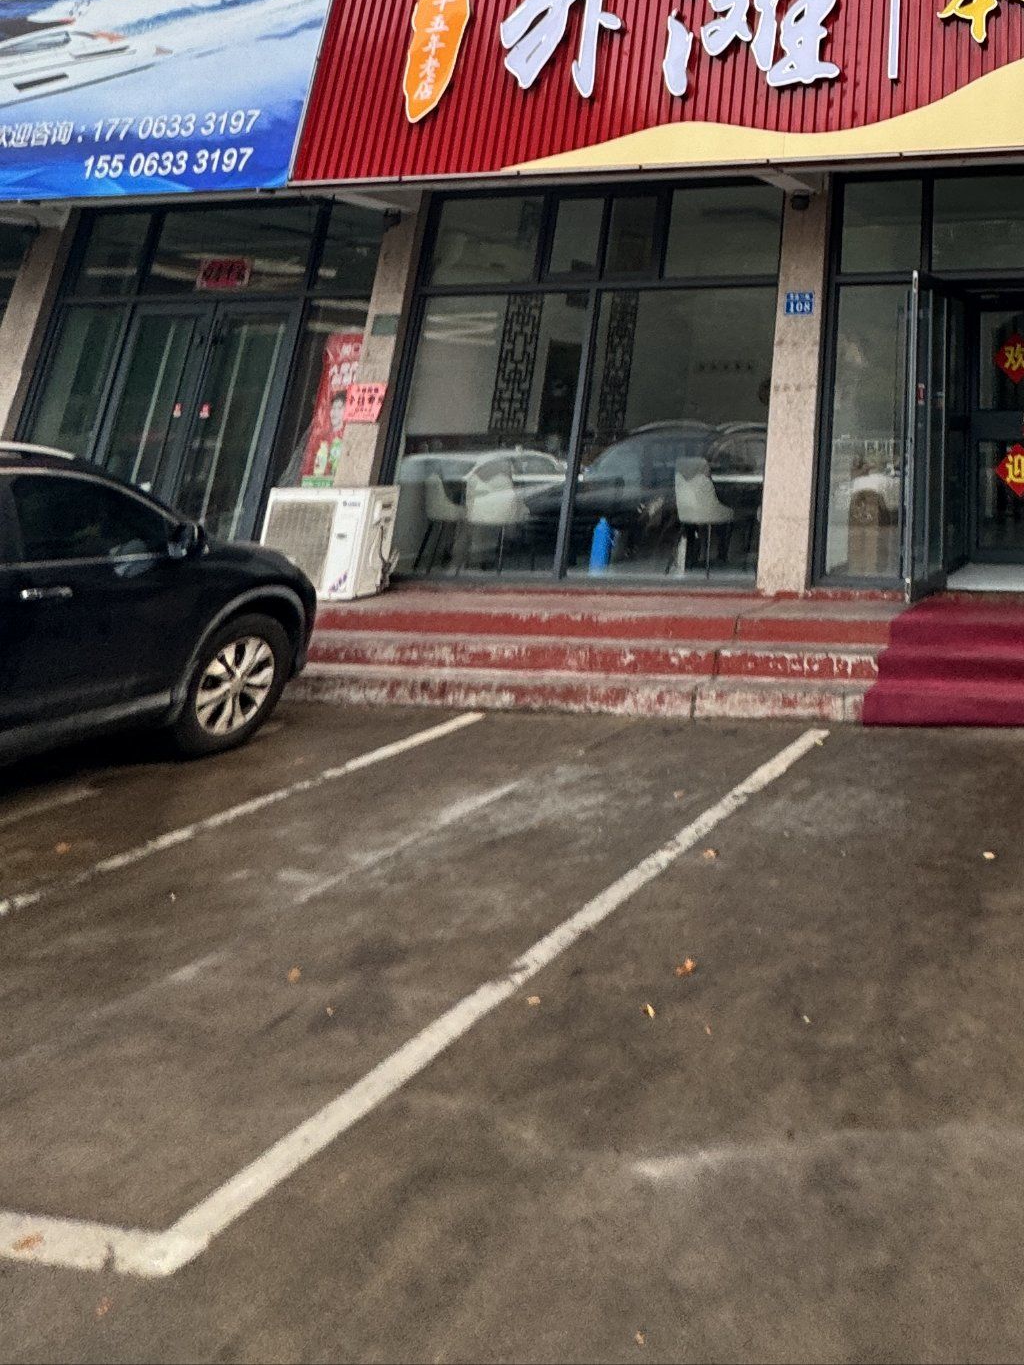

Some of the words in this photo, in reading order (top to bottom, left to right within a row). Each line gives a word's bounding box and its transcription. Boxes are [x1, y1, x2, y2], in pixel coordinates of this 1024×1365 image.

[94, 117, 133, 142] 177
[138, 113, 196, 140] 0633
[201, 109, 260, 135] 3197
[84, 154, 125, 179] 155
[129, 151, 188, 177] 0633
[193, 147, 254, 174] 3197
